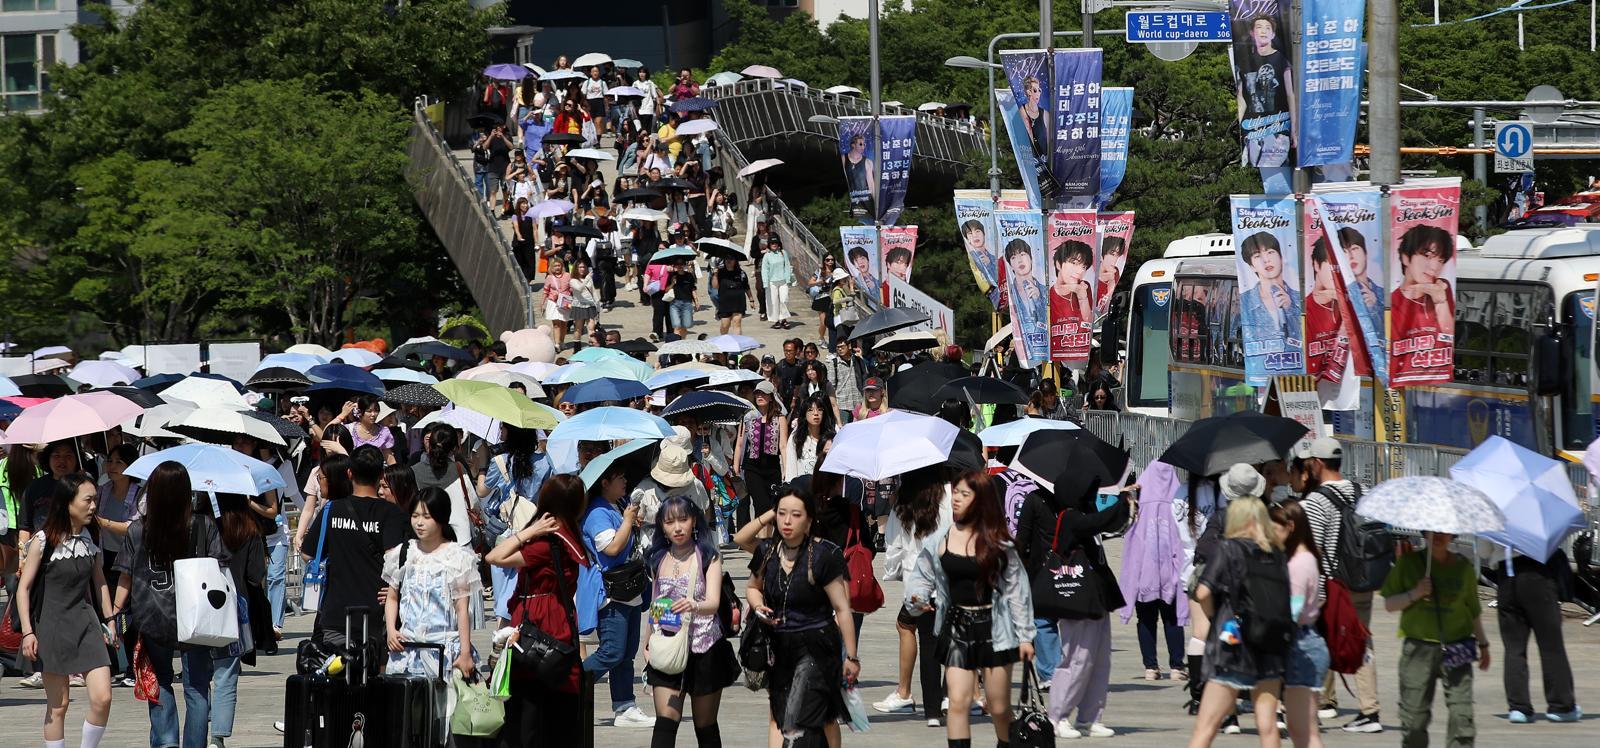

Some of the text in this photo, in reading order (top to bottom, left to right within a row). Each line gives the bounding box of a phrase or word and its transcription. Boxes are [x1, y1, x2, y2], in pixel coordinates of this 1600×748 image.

[1138, 14, 1208, 30] 월드컵대로
[1138, 30, 1209, 40] World cup-daero
[1306, 38, 1356, 55] 앞으로의
[1305, 56, 1355, 74] 모든날도
[1305, 76, 1354, 93] 함께할게
[1058, 112, 1099, 126] 13주년
[1057, 127, 1099, 140] 축하해
[1239, 209, 1257, 217] Stay
[1396, 204, 1454, 223] SeokJin
[1237, 216, 1290, 230] SeokJin
[1002, 226, 1039, 237] SeokJin
[1053, 225, 1093, 238] SeokJin
[1061, 332, 1091, 348] 석진!
[1264, 351, 1302, 370] 석진!
[1411, 347, 1453, 368] 석진!
[331, 517, 360, 531] HUMA
